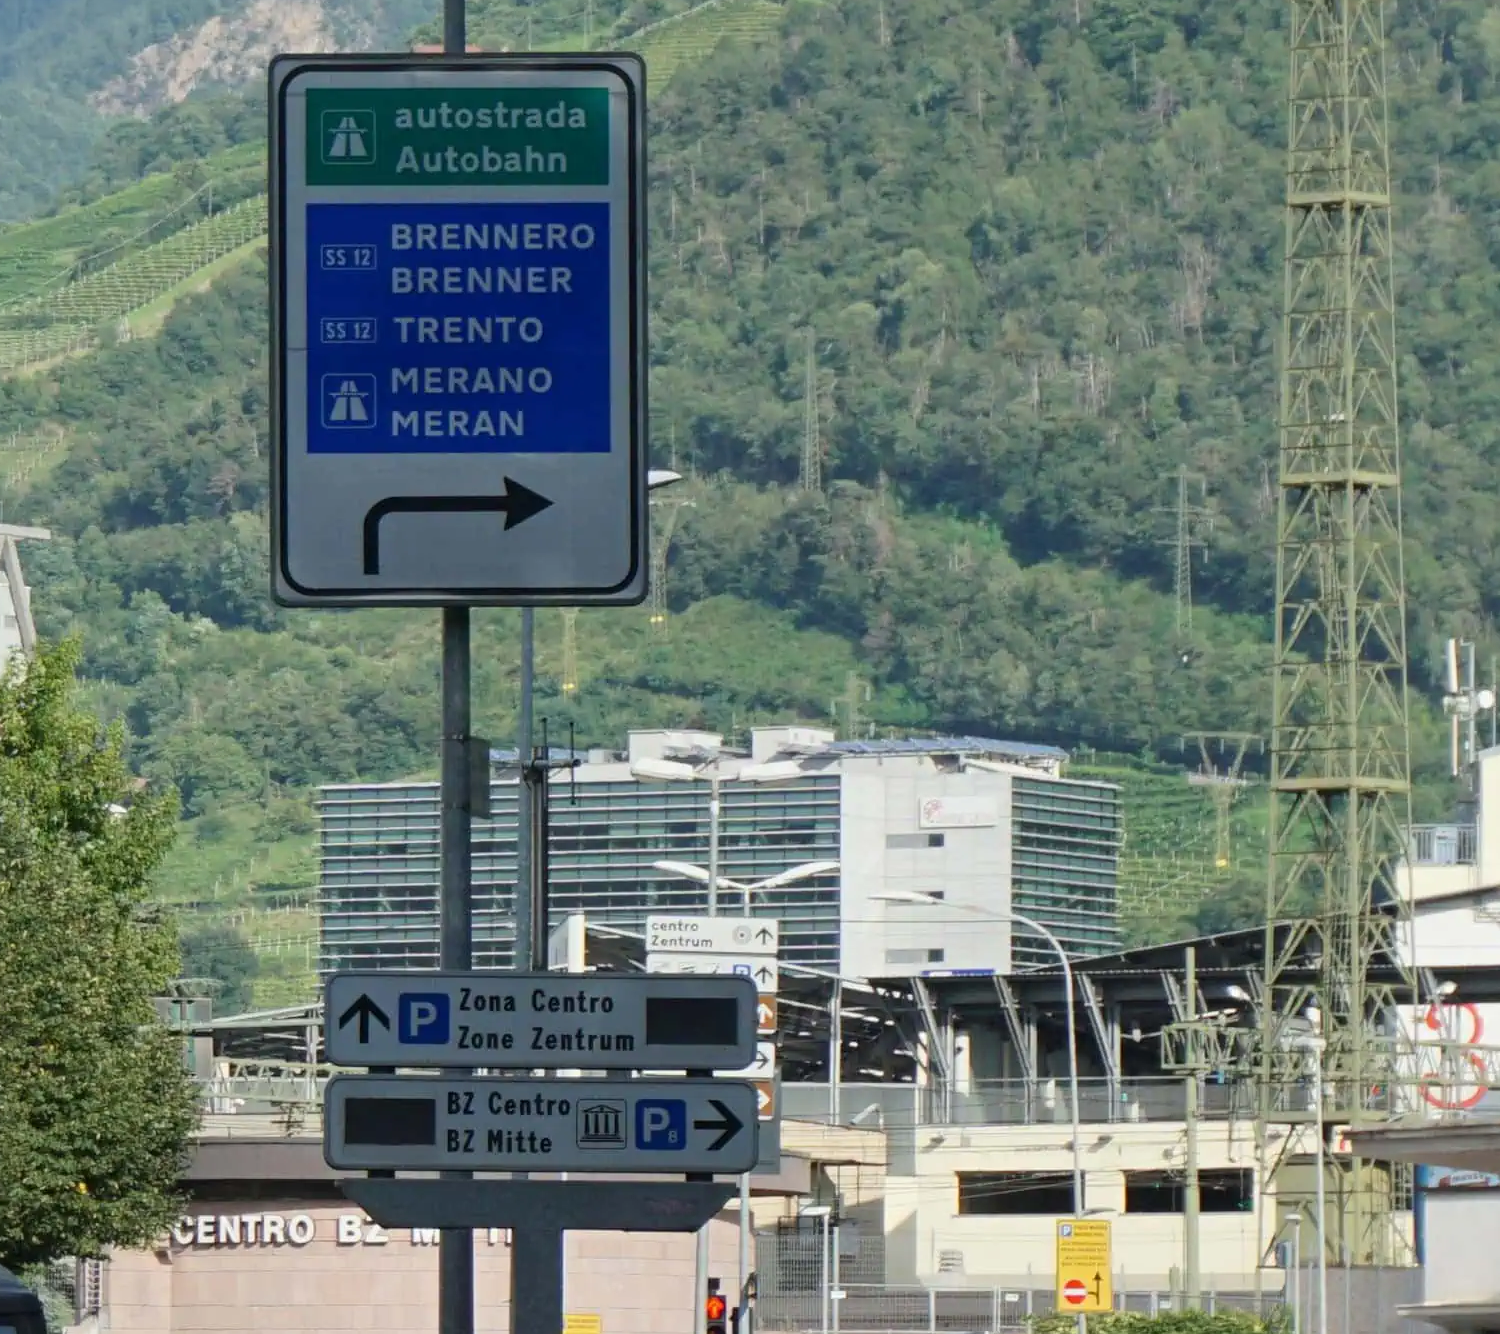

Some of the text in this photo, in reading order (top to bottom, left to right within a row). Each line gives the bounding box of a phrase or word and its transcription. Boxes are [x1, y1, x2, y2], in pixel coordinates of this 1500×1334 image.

[394, 101, 586, 128] autostrada
[395, 145, 568, 173] Autobahn
[391, 223, 595, 250] BRENNERO
[326, 250, 371, 267] SS 12
[391, 267, 573, 294] BRENNER
[326, 323, 371, 339] SS 12
[394, 317, 544, 344] TRENTO
[391, 367, 553, 394] MERANO
[391, 411, 525, 437] MERAN
[652, 920, 699, 932] centro
[651, 935, 713, 948] Zentrum
[411, 988, 615, 1037] P Zona Centro
[457, 1026, 635, 1052] Zone Zentrum
[447, 1091, 571, 1117] BZ Centro
[447, 1130, 552, 1154] BZ Mitte
[174, 1214, 316, 1246] CENTRO
[336, 1215, 389, 1244] BZ
